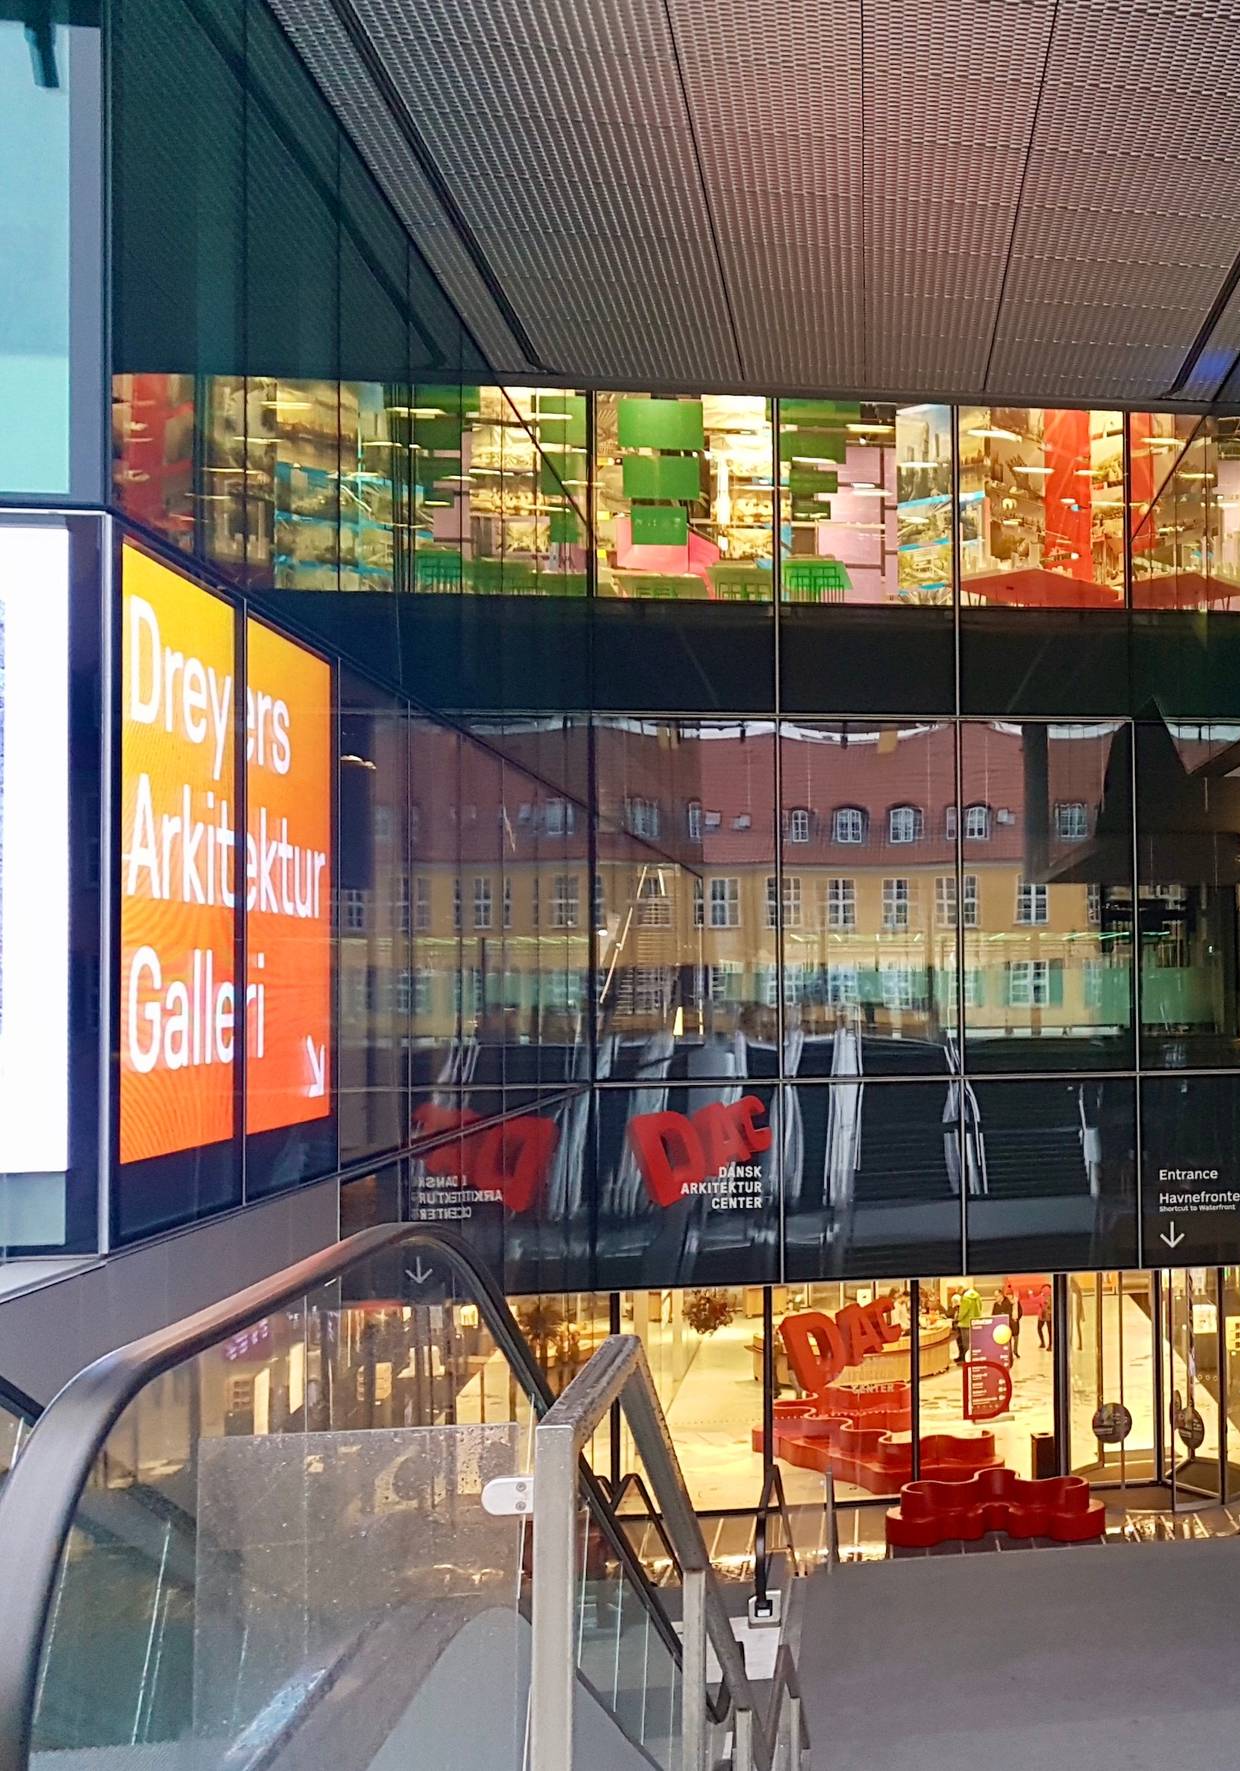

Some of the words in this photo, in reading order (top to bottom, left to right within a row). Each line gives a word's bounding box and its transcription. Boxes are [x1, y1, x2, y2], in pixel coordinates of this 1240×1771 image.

[123, 773, 326, 918] Arkitektur
[629, 1095, 773, 1208] DAC
[719, 1166, 762, 1178] DANSK
[1159, 1168, 1219, 1181] Entrance
[680, 1181, 762, 1195] ARKITEKTUR
[711, 1197, 762, 1209] CENTER
[1199, 1203, 1236, 1211] Waterfront
